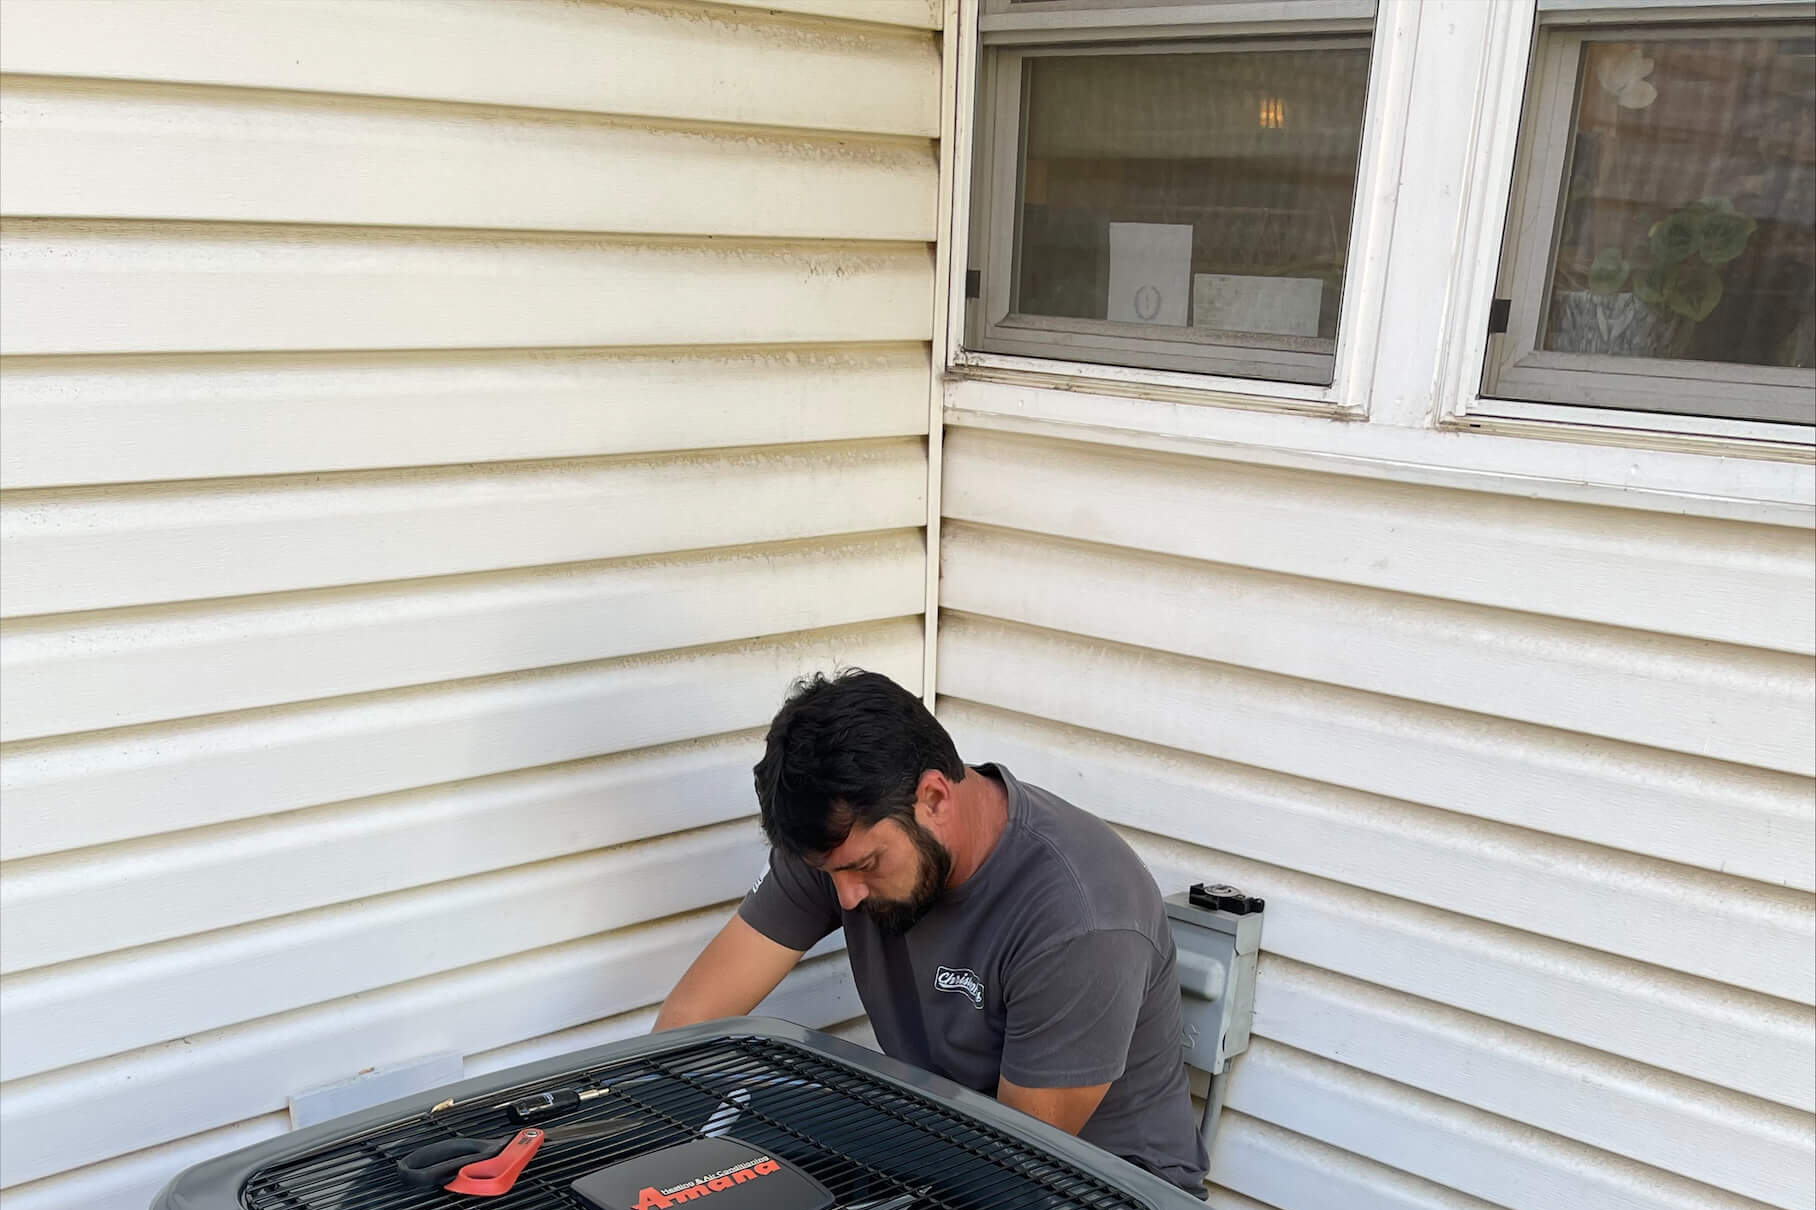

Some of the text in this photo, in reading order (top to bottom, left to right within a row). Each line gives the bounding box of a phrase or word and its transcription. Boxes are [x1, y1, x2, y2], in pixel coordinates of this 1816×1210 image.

[660, 1181, 695, 1196] Heating
[703, 1174, 715, 1183] Air
[716, 1155, 770, 1177] Conditioning
